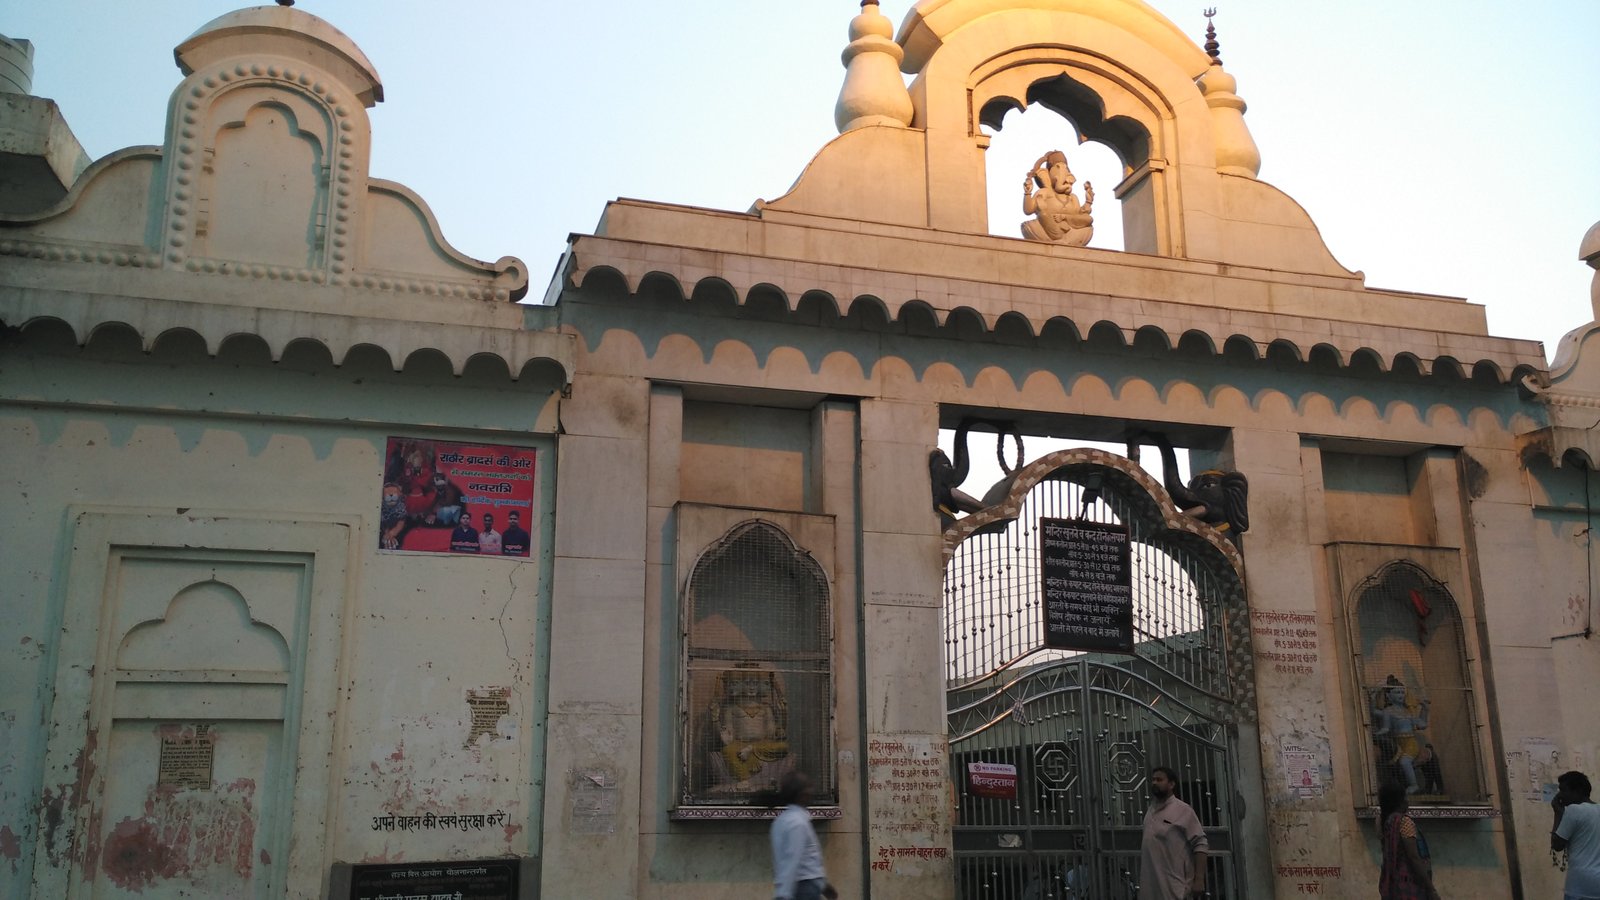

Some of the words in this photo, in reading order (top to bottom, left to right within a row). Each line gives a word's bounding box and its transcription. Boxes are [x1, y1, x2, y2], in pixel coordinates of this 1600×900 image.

[496, 455, 510, 466] की
[512, 457, 532, 468] ओर
[468, 482, 513, 494] नवरात्रि
[1108, 554, 1119, 562] तक
[972, 774, 1015, 789] हिन्दुस्तान
[372, 812, 395, 831] अपने
[398, 814, 420, 833] वाहन
[422, 812, 436, 830] की
[439, 812, 458, 830] स्वयं
[458, 814, 485, 832] सुरक्षा
[878, 845, 889, 858] गेट
[889, 844, 896, 857] के
[897, 845, 916, 858] सामने
[917, 848, 933, 861] वाहन
[872, 861, 878, 871] न
[1297, 884, 1304, 894] न
